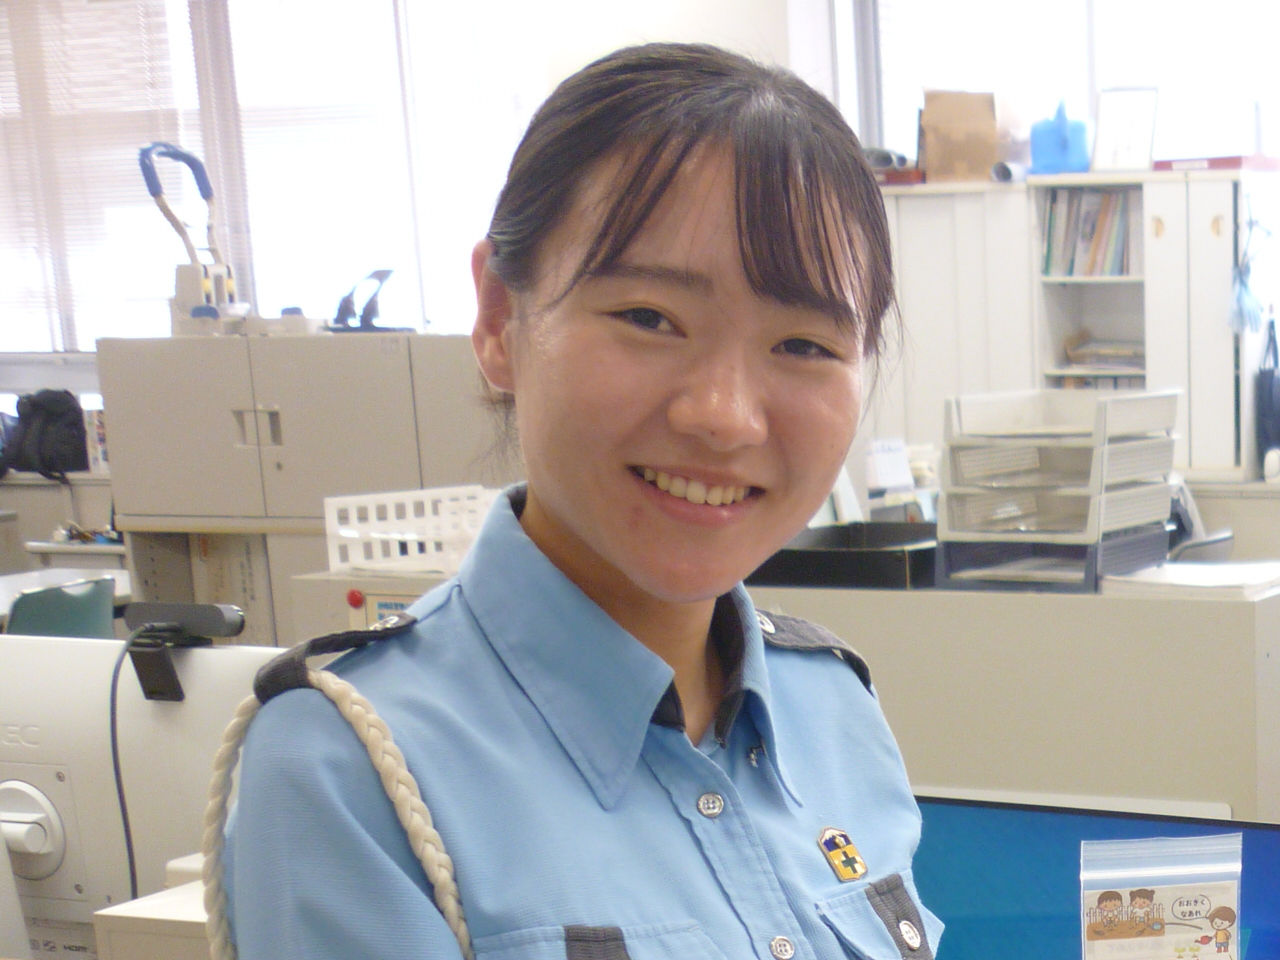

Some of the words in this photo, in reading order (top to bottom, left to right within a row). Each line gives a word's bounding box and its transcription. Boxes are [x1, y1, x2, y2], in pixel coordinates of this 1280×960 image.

[1177, 898, 1206, 909] おおきく
[1180, 909, 1202, 919] なあれ
